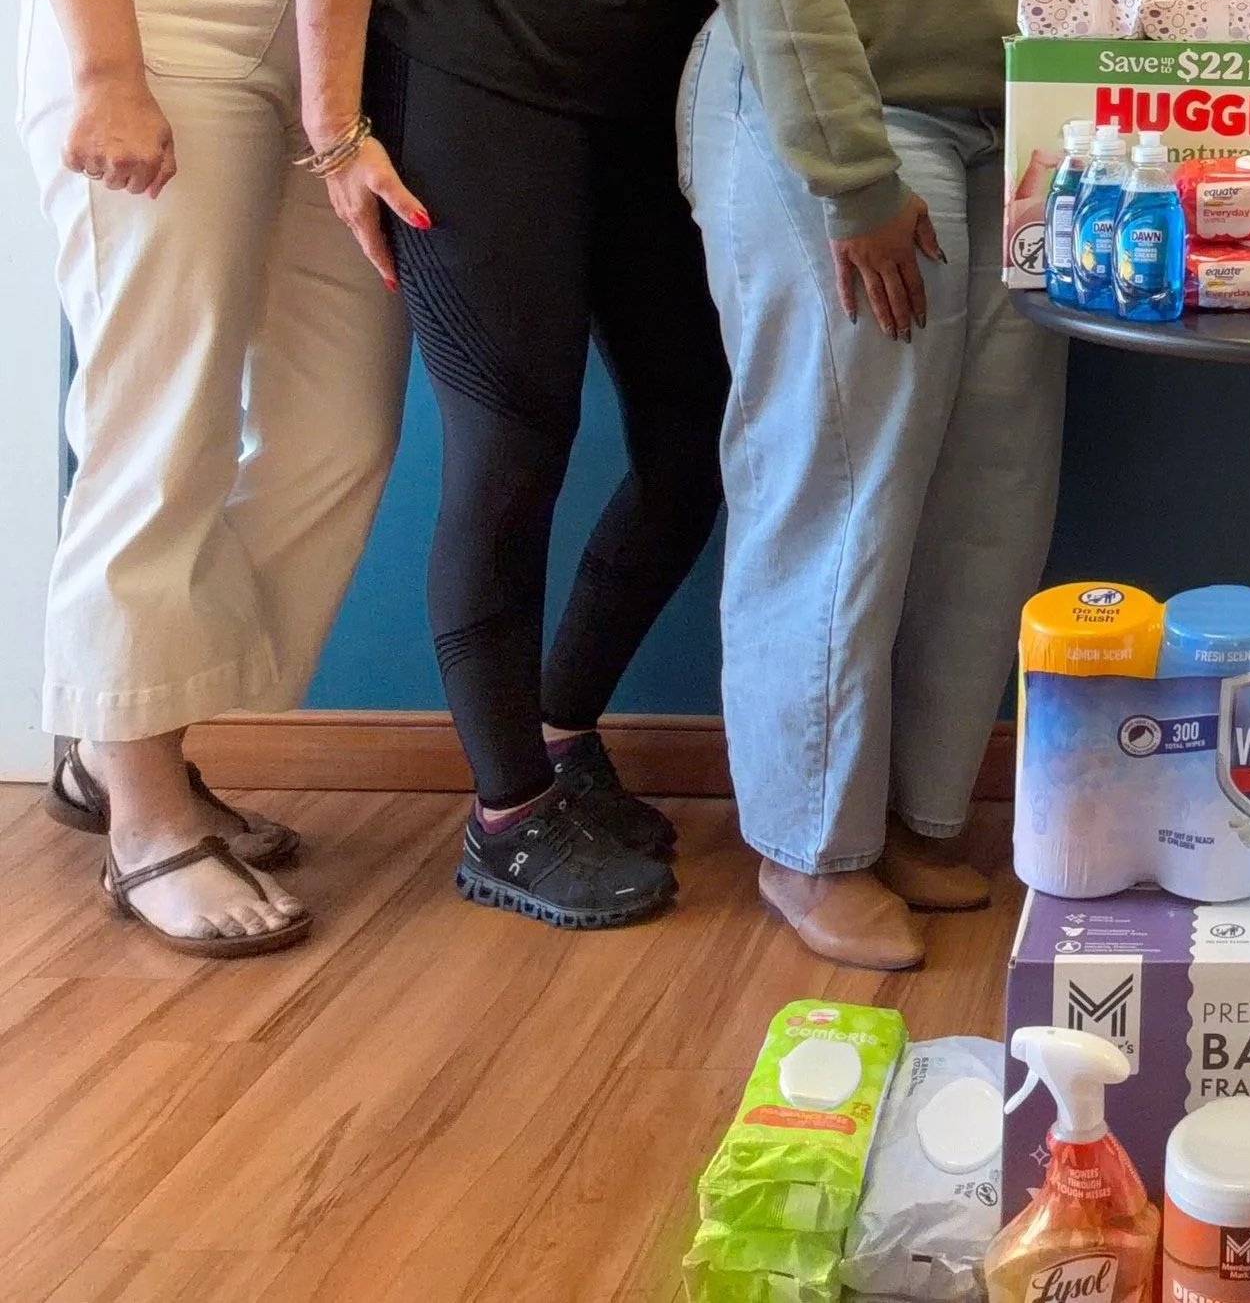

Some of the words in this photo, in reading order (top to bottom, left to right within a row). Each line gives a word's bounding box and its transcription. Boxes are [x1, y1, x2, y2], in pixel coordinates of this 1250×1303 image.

[1099, 50, 1158, 73] Save
[1160, 56, 1175, 66] up
[1176, 48, 1243, 83] $22
[1160, 64, 1172, 74] to
[1203, 187, 1241, 199] equate
[1203, 209, 1250, 218] Everyday
[1093, 222, 1113, 234] DAW
[1131, 231, 1162, 243] DAWN
[1205, 267, 1242, 279] equate
[1072, 607, 1092, 615] Do
[1096, 607, 1121, 615] Not
[1075, 614, 1115, 623] Flush
[1194, 648, 1226, 663] FRESH
[1172, 720, 1200, 743] 300
[1164, 742, 1184, 750] TOTAL
[1056, 1182, 1085, 1198] TOUGH
[1031, 1259, 1112, 1303] Lysol
[1229, 1270, 1250, 1280] Mark
